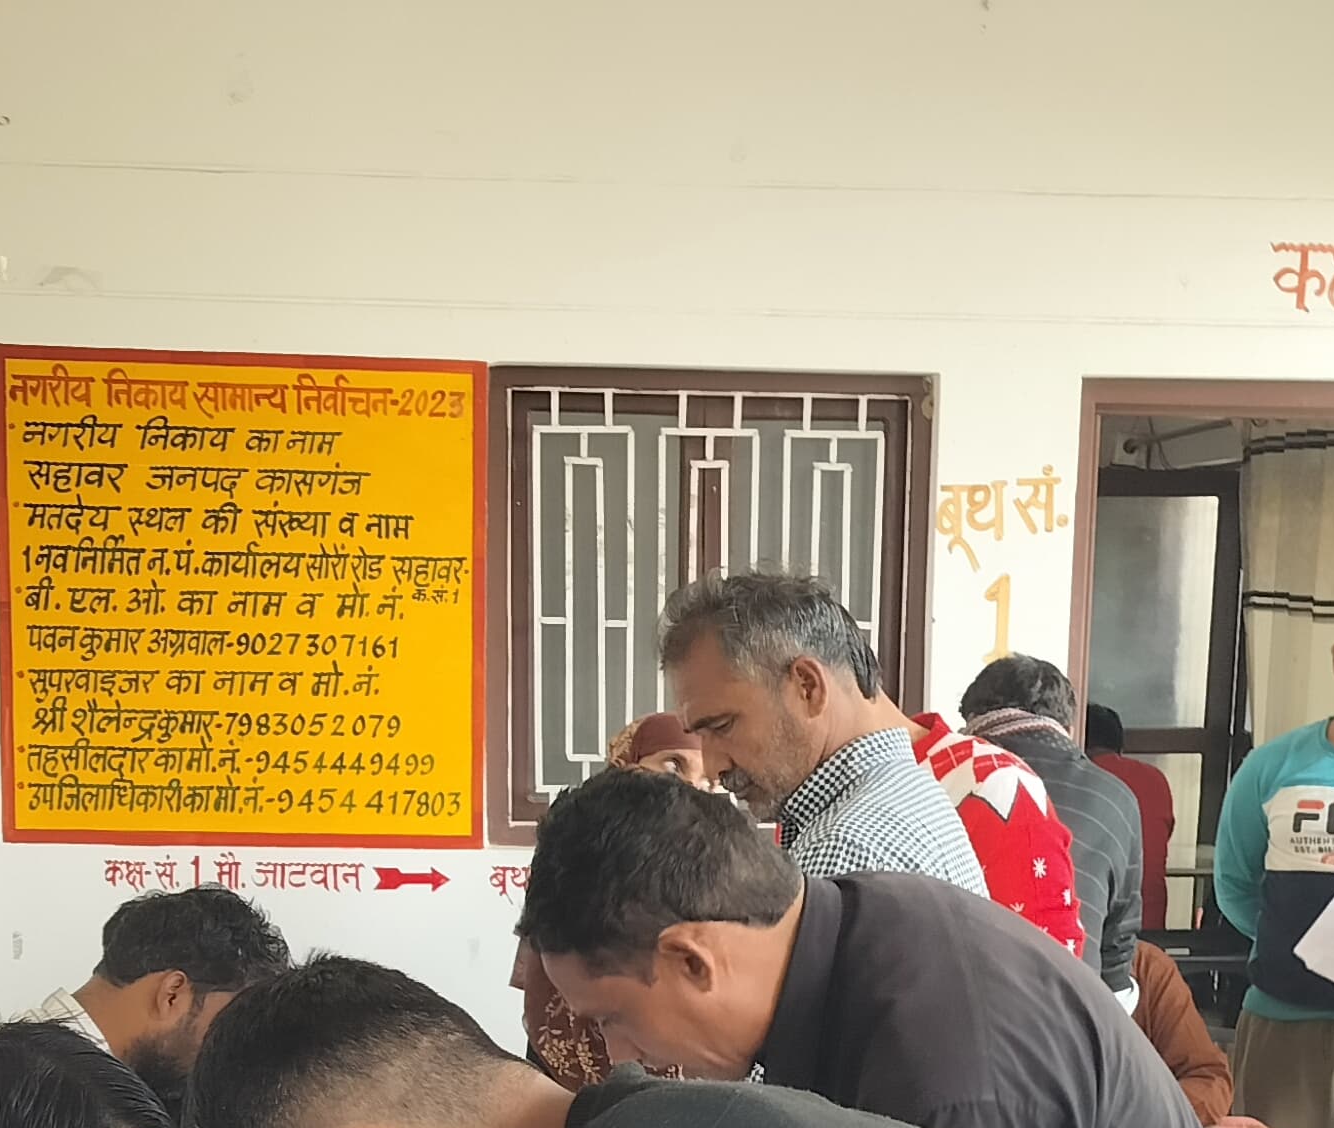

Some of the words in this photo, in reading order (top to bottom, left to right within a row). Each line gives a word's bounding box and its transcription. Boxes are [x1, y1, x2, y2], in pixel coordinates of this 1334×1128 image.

[9, 363, 95, 407] नगरीय
[103, 368, 189, 410] निकाय
[193, 382, 288, 419] सामान्य
[23, 415, 123, 451] नगरीय
[136, 416, 235, 452] निकाय
[246, 429, 284, 453] का
[287, 430, 342, 456] नाम
[23, 460, 128, 493] सहावर
[146, 466, 248, 499] जनपद
[255, 462, 371, 497] कासगंज
[24, 494, 122, 535] मतदेय
[128, 507, 192, 536] स्थल
[202, 502, 243, 534] की
[252, 500, 331, 538] संख्या
[339, 512, 359, 537] व
[366, 514, 414, 540] नाम
[936, 480, 1008, 572] बूथ
[352, 546, 385, 581] रोड
[177, 590, 218, 616] का
[227, 591, 287, 617] नाम
[296, 592, 324, 618] व
[982, 573, 1011, 662] 1
[27, 625, 80, 653] पवन
[79, 627, 145, 662] कुमार
[28, 669, 159, 703] सुपरवाइजर
[166, 669, 206, 695] का
[213, 670, 273, 696] नाम
[278, 671, 303, 696] व
[32, 696, 67, 735] श्री
[27, 738, 155, 778] तहसीलदार
[191, 855, 201, 889] 1
[252, 860, 365, 892] जाटवान
